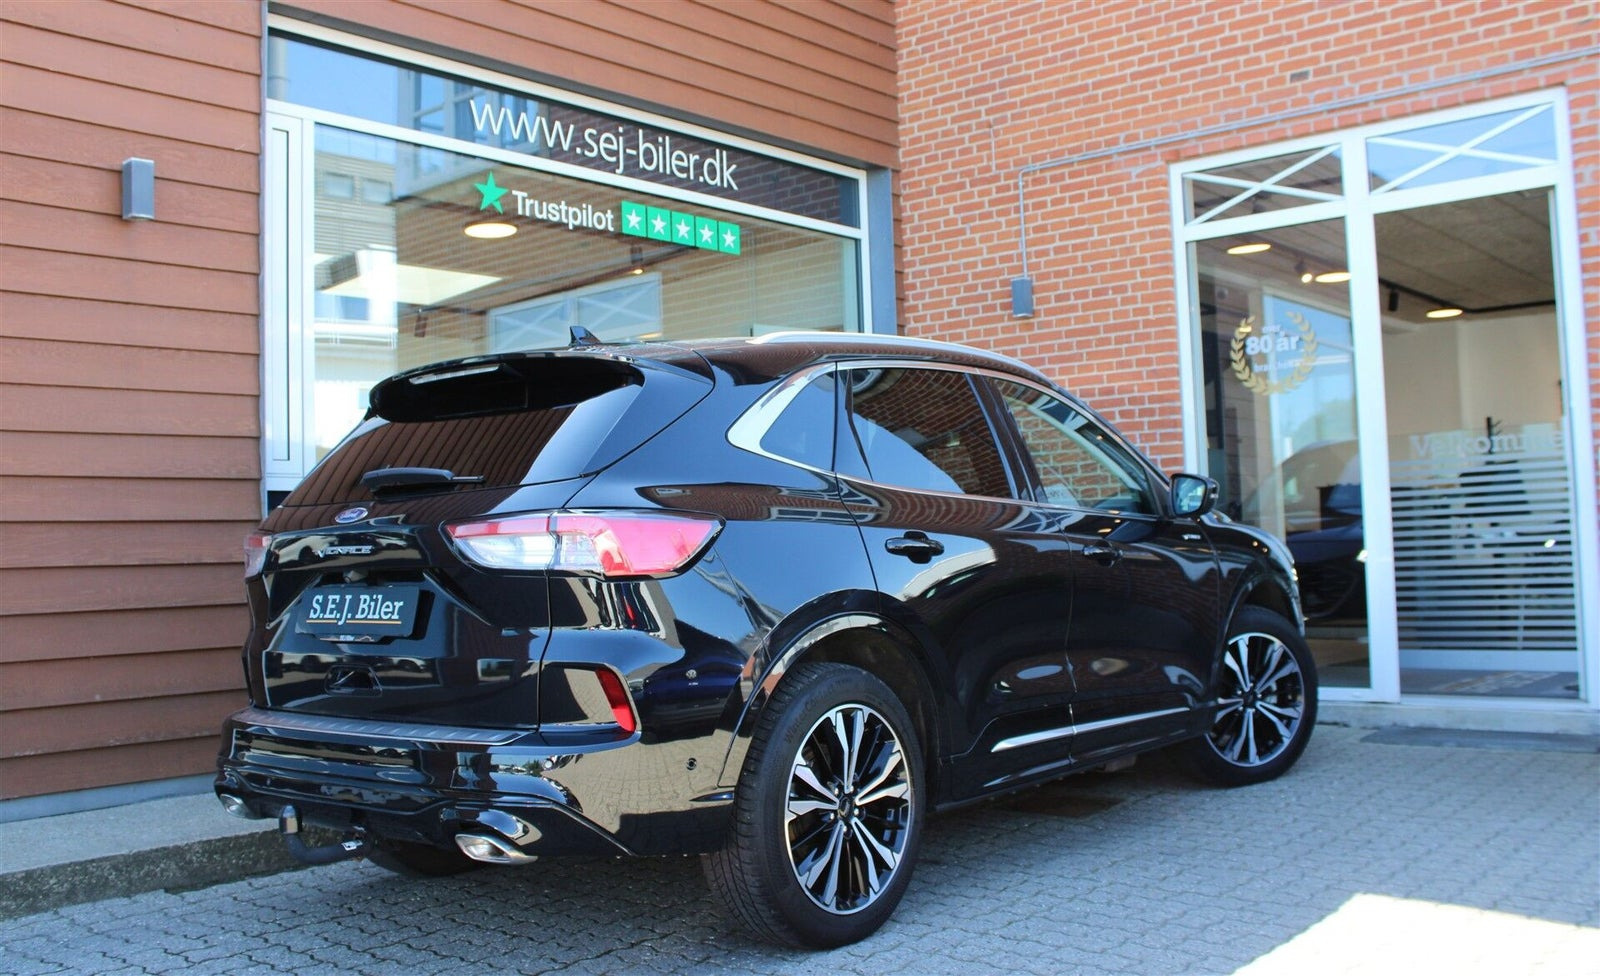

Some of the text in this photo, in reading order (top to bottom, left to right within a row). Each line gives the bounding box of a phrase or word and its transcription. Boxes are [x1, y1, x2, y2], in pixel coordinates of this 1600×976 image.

[470, 99, 739, 190] www.sej-biler.dk
[512, 190, 614, 232] Trustpilot
[1245, 330, 1300, 355] 80 år
[309, 594, 404, 626] S.E.J. Biler
